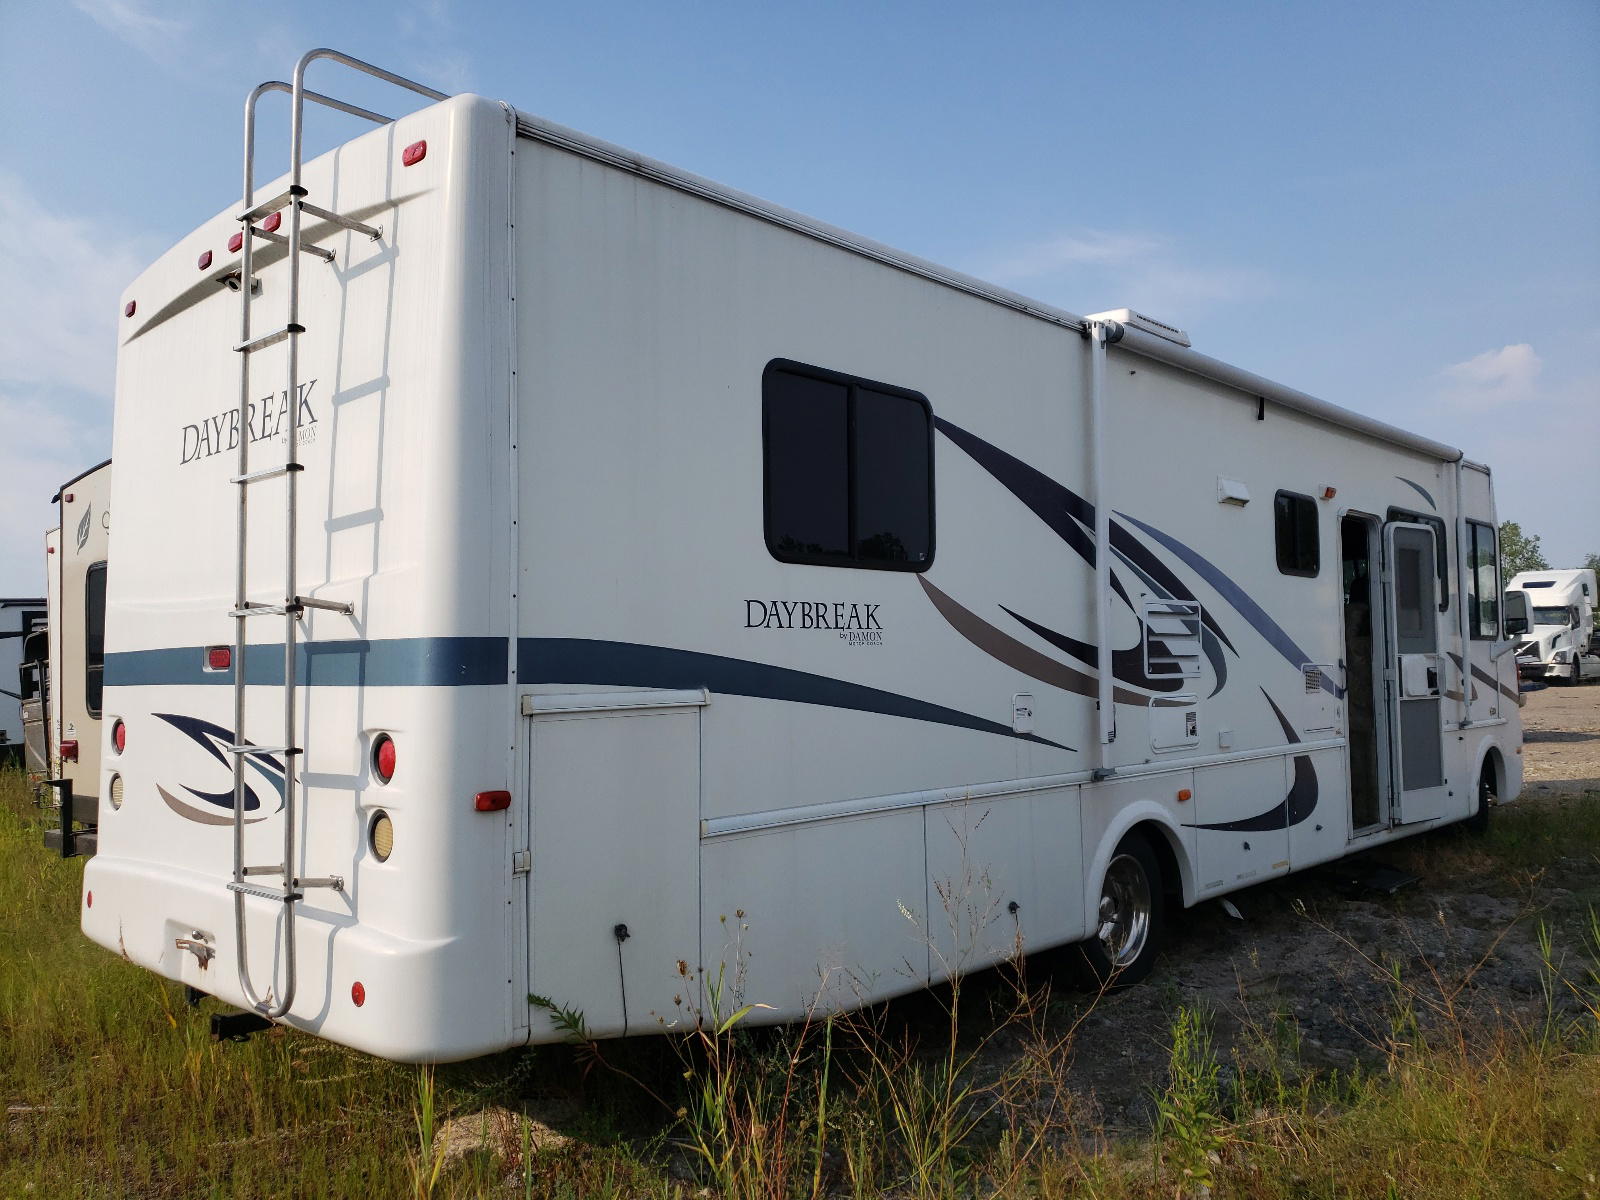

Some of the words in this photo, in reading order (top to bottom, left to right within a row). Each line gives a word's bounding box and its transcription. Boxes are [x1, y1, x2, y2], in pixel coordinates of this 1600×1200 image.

[743, 599, 884, 631] DAYBREAK
[839, 632, 848, 640] by
[848, 631, 883, 642] DAMON
